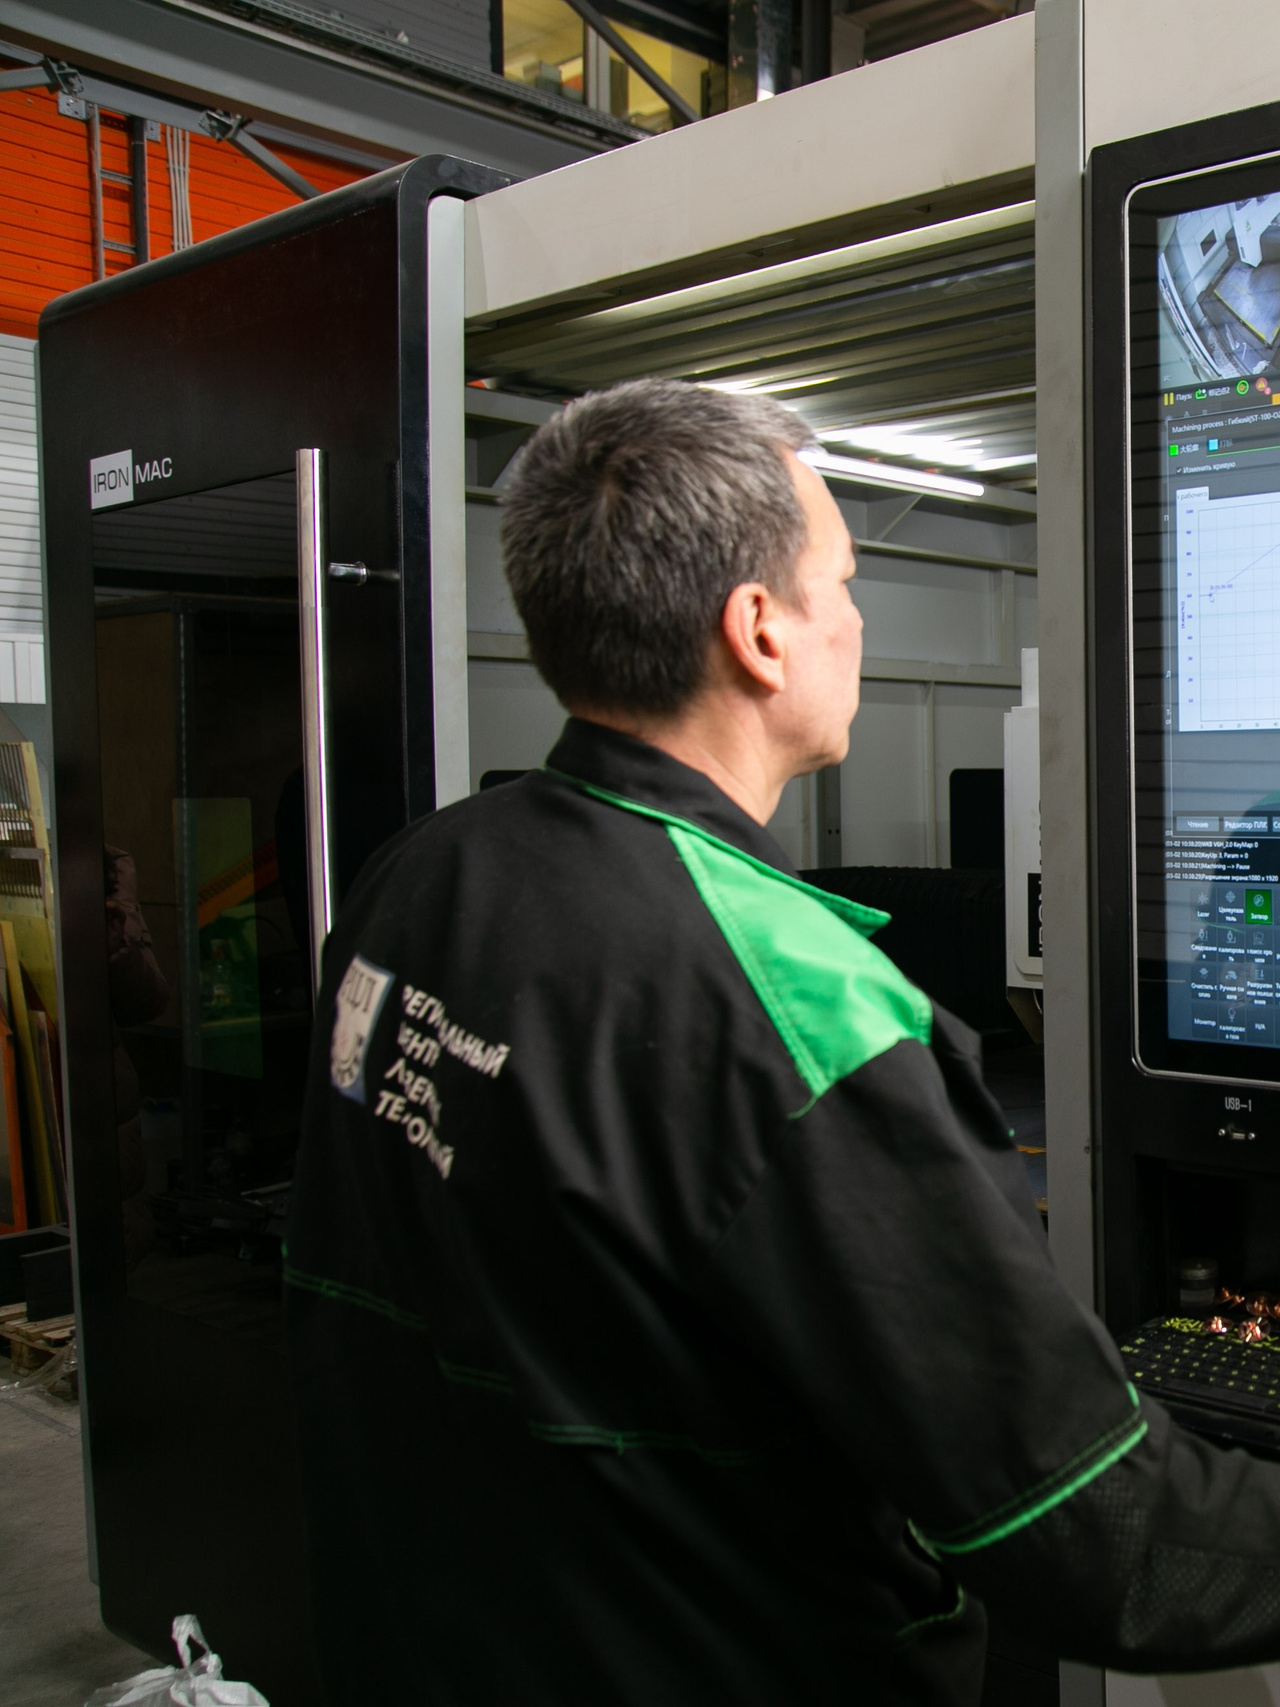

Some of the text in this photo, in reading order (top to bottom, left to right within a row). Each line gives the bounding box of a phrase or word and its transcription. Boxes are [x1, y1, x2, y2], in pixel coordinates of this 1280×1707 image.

[1172, 424, 1201, 433] Machining
[1203, 421, 1224, 430] process
[1183, 461, 1236, 474] Изменить кривую
[94, 457, 173, 493] IRON MAC
[1181, 491, 1208, 500] рабочего
[1188, 821, 1209, 829] Чтение
[1225, 821, 1252, 830] Редактор
[1255, 1023, 1266, 1031] N/A
[1225, 1097, 1252, 1112] USB-1
